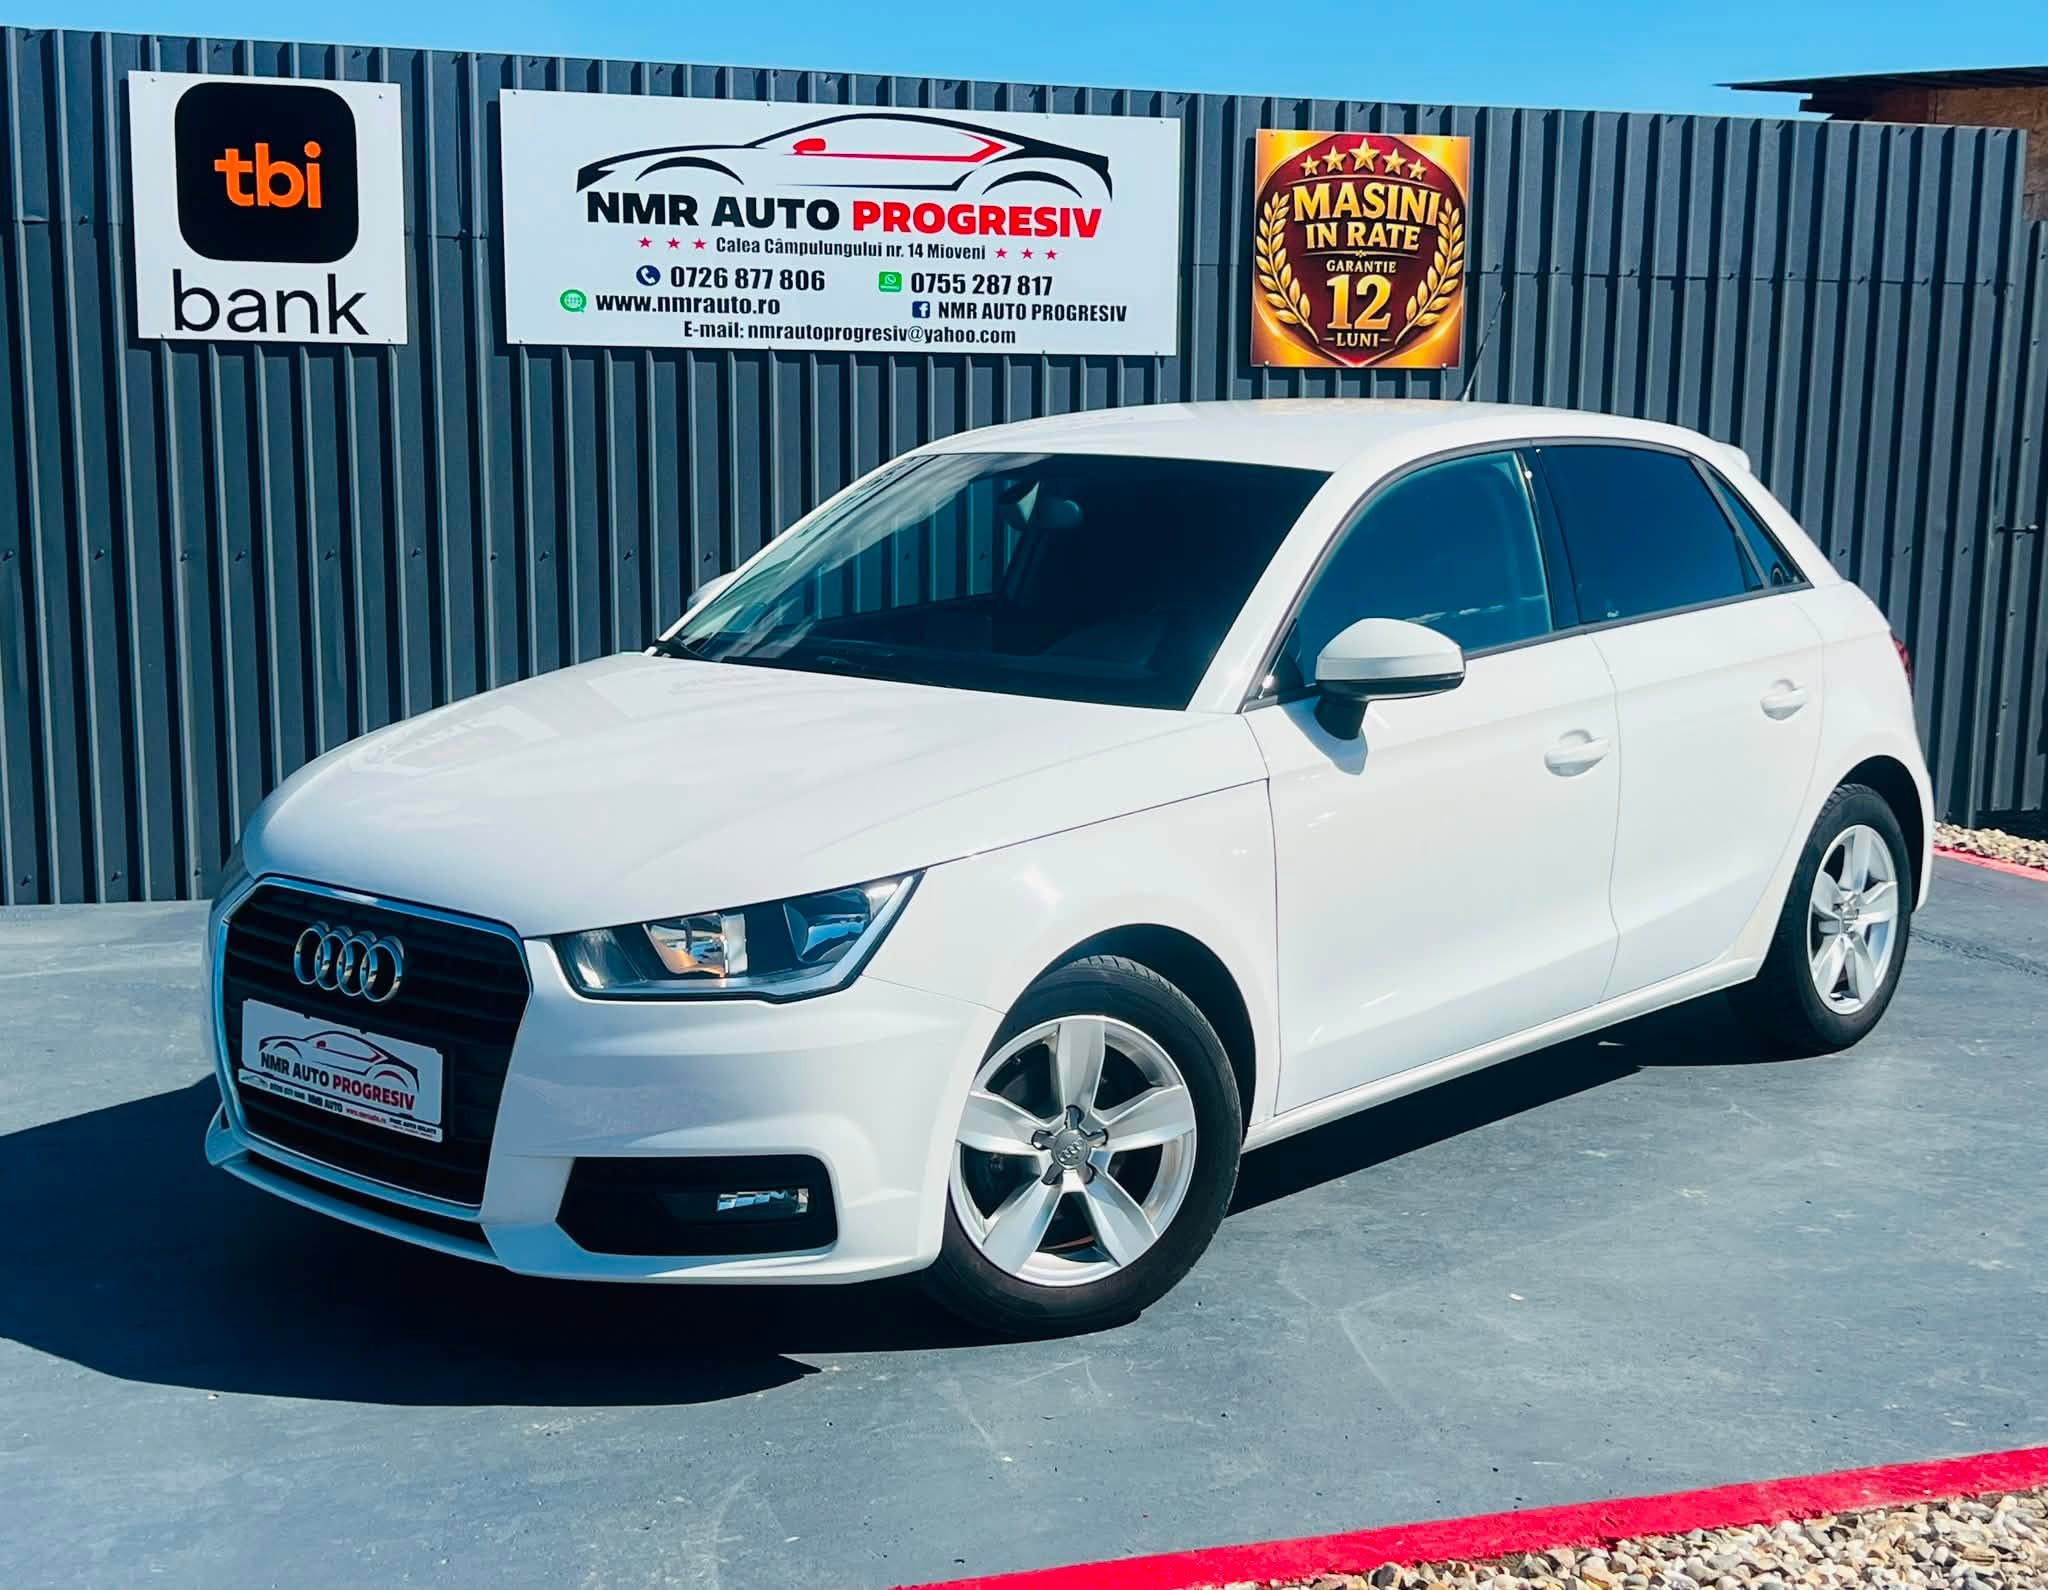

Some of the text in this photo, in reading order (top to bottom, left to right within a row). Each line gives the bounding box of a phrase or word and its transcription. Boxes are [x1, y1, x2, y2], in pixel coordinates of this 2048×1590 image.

[214, 141, 322, 209] tbi
[587, 191, 1102, 238] NMR AUTO PROGRESIV
[1292, 182, 1442, 227] MASINI
[716, 236, 985, 260] Calea Câmpulungului nr. 14 Mioveni
[1305, 222, 1421, 251] IN RATE
[670, 266, 826, 291] 0726 877 806
[1326, 259, 1397, 273] GARANTIE
[911, 272, 1053, 297] 0755 287 817
[172, 268, 369, 336] bank
[595, 294, 781, 315] www.nmrauto.ro
[938, 301, 1128, 323] NMR AUTO PROGRESIV
[1326, 274, 1392, 330] 12
[684, 321, 1016, 344] E-mail: nmrautoprogresiv@yahoo.com
[1336, 332, 1379, 347] LUNI
[260, 1052, 290, 1076] NMR
[292, 1062, 330, 1087] AUTO
[332, 1074, 416, 1111] PROGRESIV
